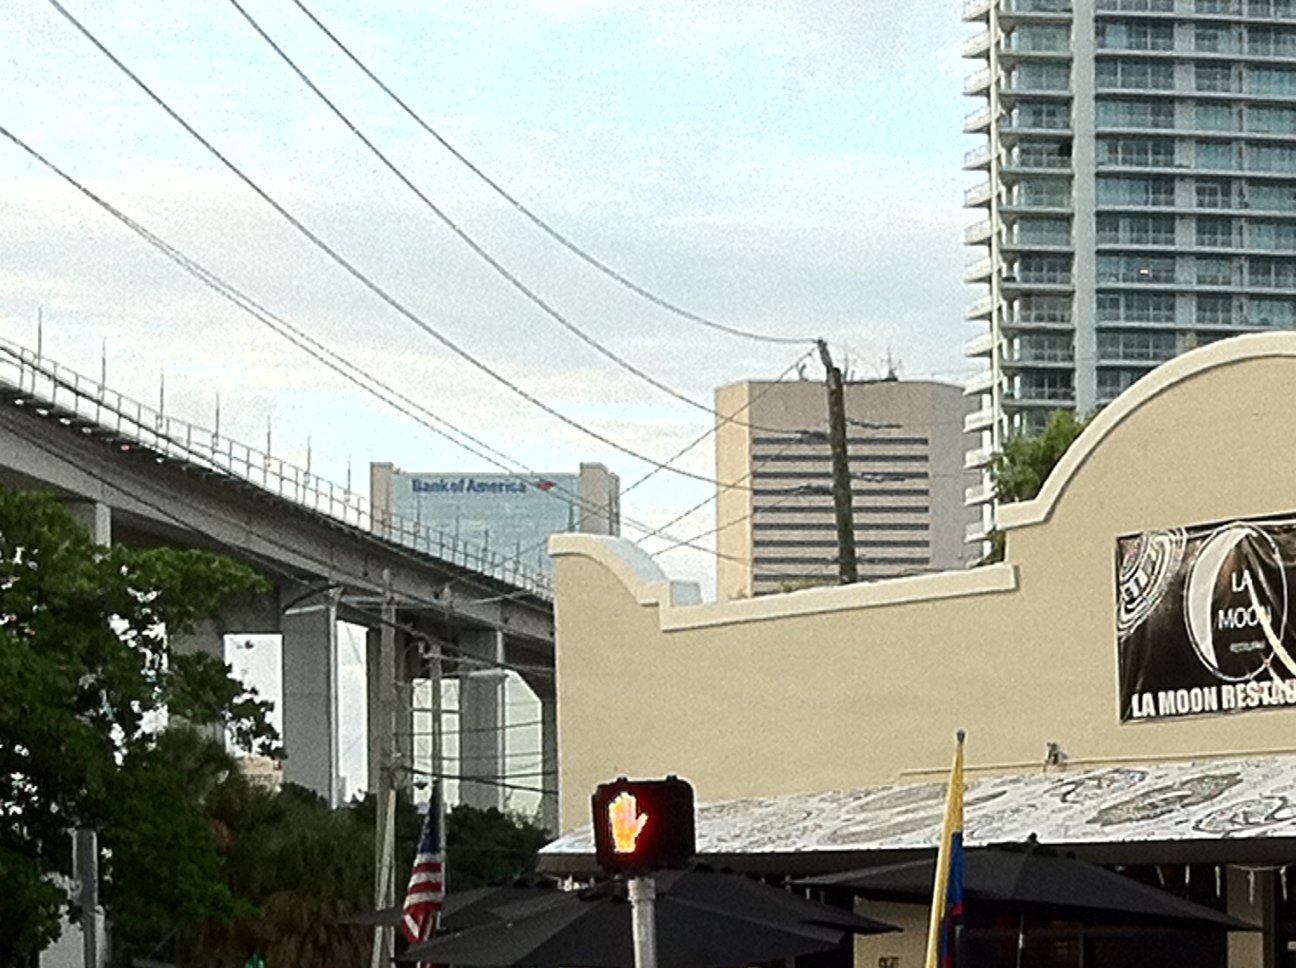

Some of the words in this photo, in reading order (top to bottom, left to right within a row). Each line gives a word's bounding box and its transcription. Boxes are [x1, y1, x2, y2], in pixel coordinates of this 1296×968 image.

[411, 478, 449, 493] Bank
[450, 478, 465, 493] of
[466, 478, 527, 493] America
[1231, 569, 1252, 592] LA
[1131, 692, 1156, 718] LA
[1158, 686, 1218, 716] MOON
